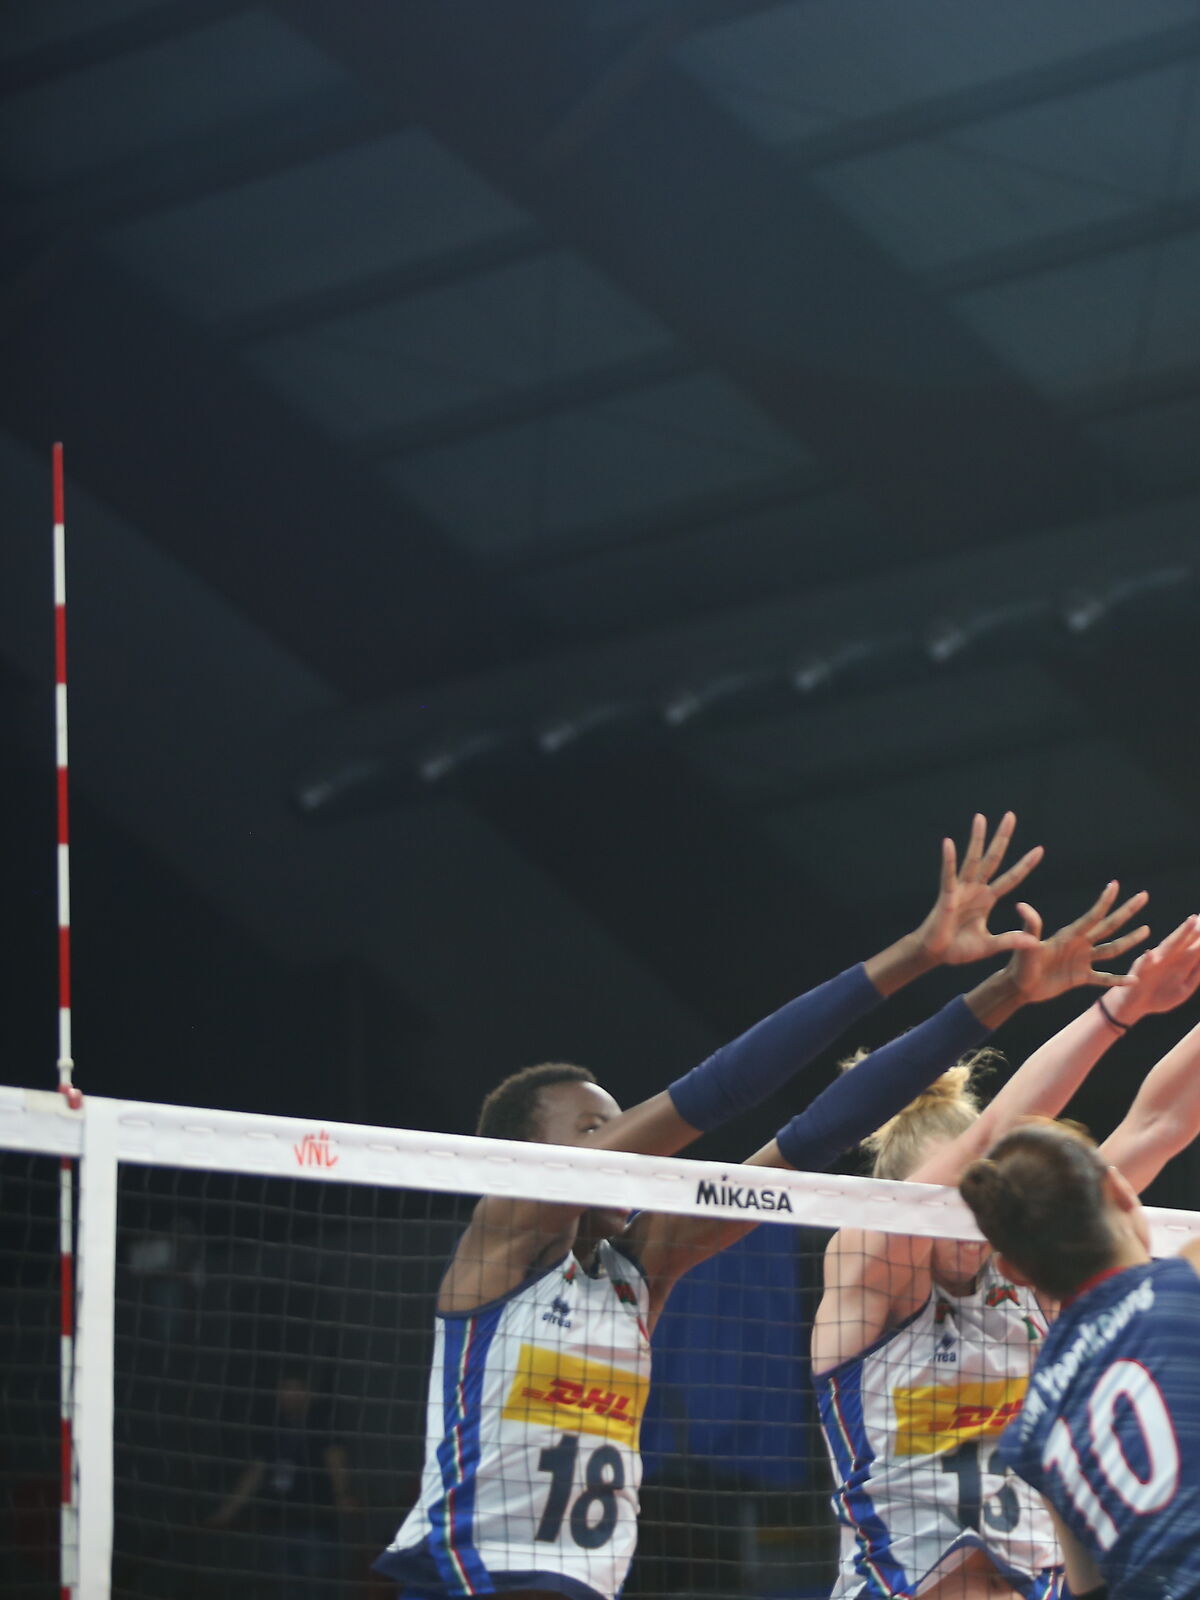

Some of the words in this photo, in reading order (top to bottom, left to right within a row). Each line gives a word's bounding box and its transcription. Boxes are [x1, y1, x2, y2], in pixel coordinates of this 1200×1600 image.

[696, 1173, 793, 1213] MIKASA
[545, 1379, 631, 1422] DHL
[950, 1399, 1025, 1429] DH
[1042, 1358, 1181, 1550] 10
[534, 1434, 625, 1550] 18
